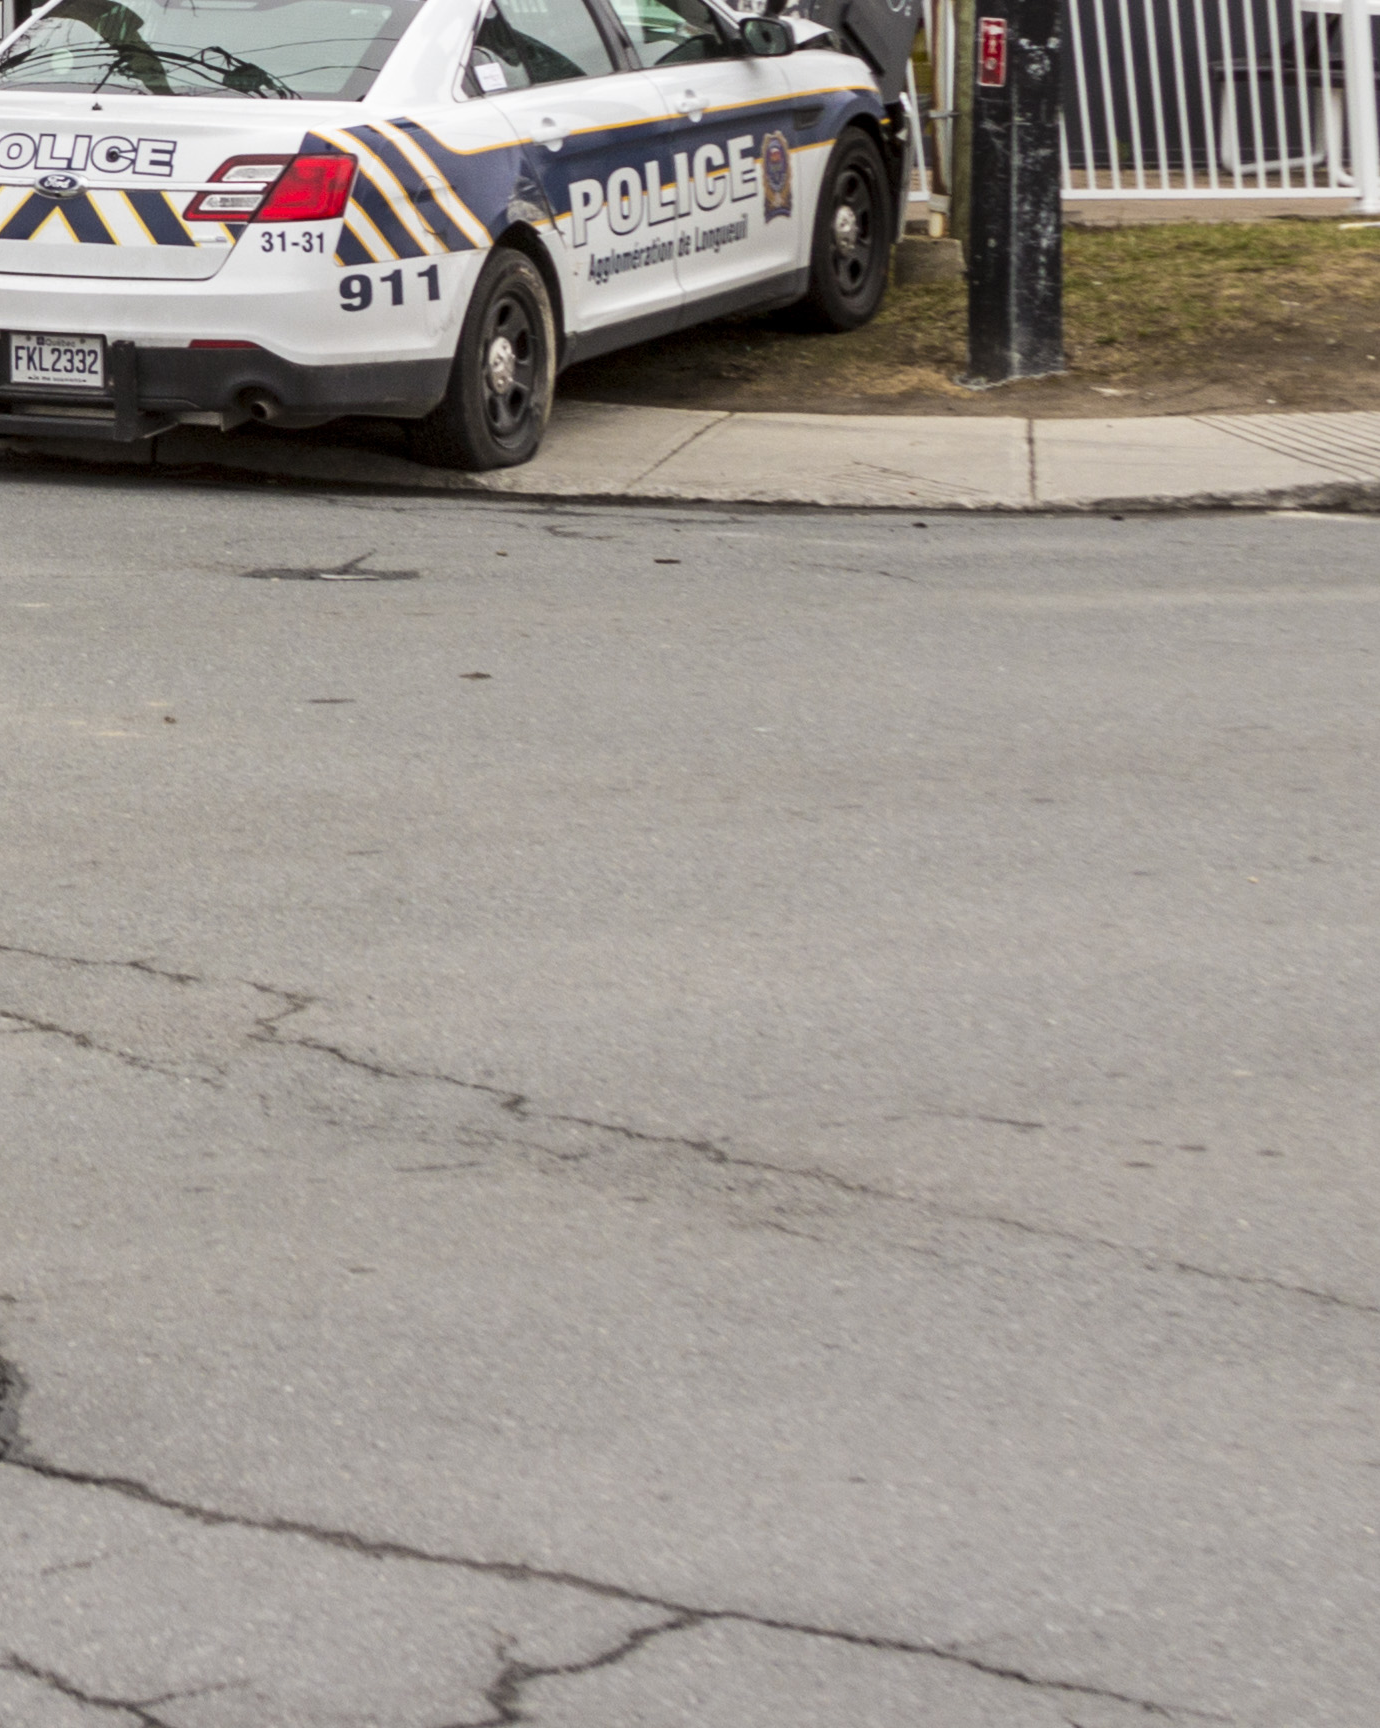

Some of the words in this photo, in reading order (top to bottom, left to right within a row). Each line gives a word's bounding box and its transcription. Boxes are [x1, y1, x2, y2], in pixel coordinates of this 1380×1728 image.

[43, 175, 71, 190] Ford
[568, 134, 759, 249] POLICE
[261, 231, 325, 254] 31-31
[589, 237, 674, 285] Agglomération
[677, 230, 691, 257] de
[694, 213, 748, 253] Longueuil
[339, 264, 441, 312] 911
[14, 345, 99, 375] FKL2332
